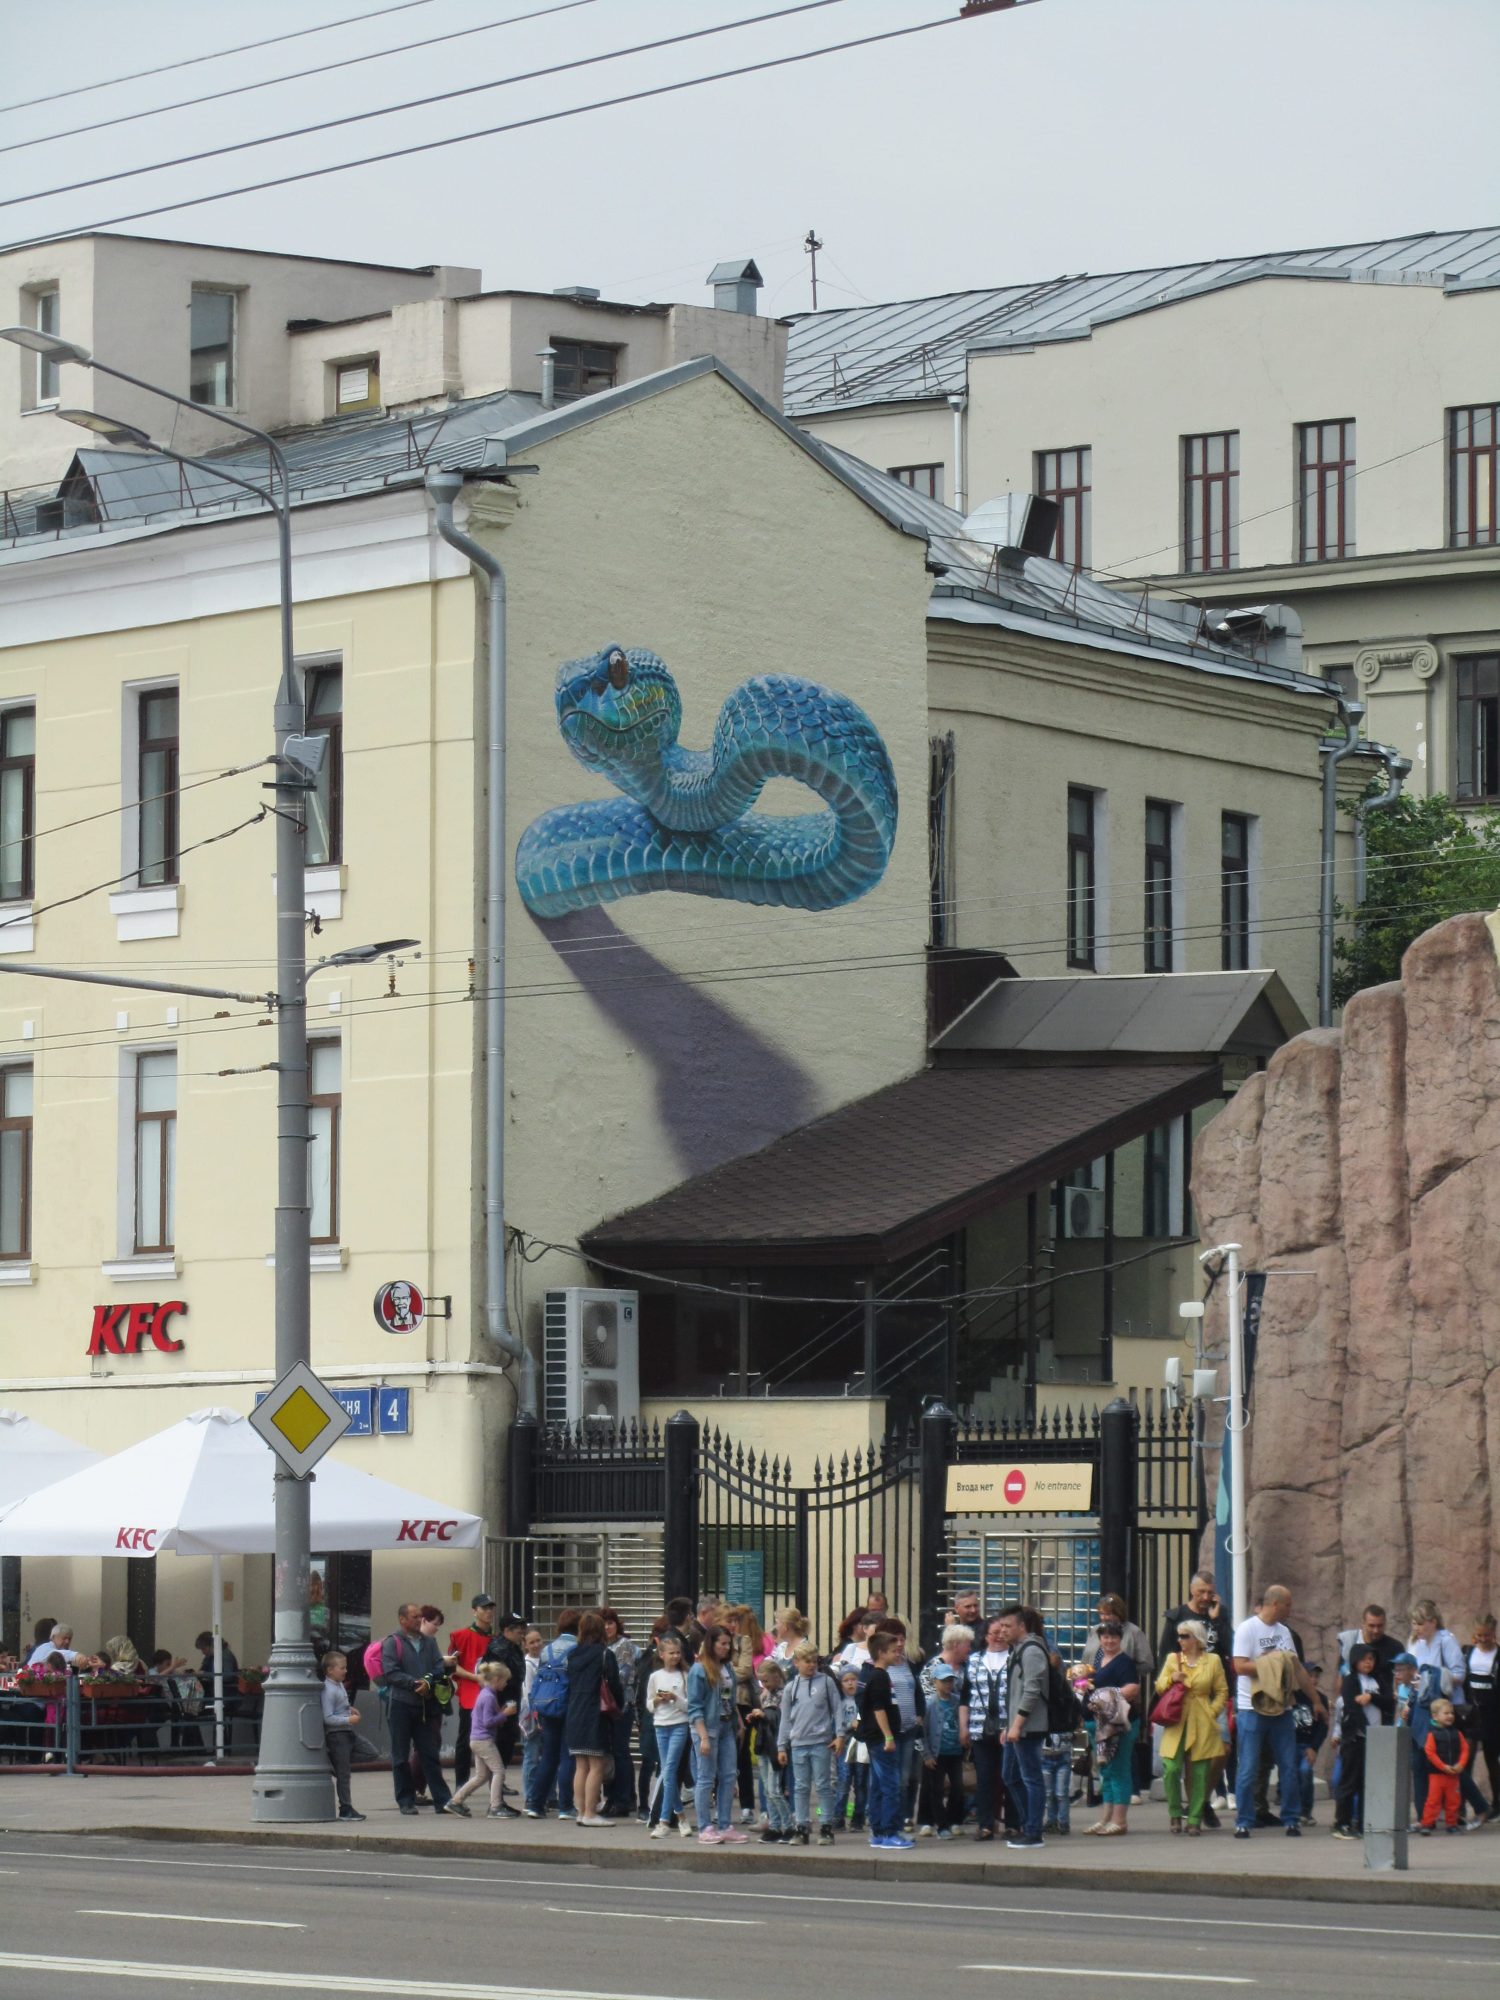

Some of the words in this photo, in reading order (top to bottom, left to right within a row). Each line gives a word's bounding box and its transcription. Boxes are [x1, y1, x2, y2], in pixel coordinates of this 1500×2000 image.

[86, 1301, 186, 1355] KFC
[387, 1398, 399, 1422] 4
[956, 1482, 978, 1493] Входа
[981, 1483, 994, 1491] нет
[1034, 1481, 1045, 1490] No
[1047, 1481, 1081, 1490] entrance
[116, 1527, 157, 1551] KFC
[396, 1520, 458, 1541] KFC
